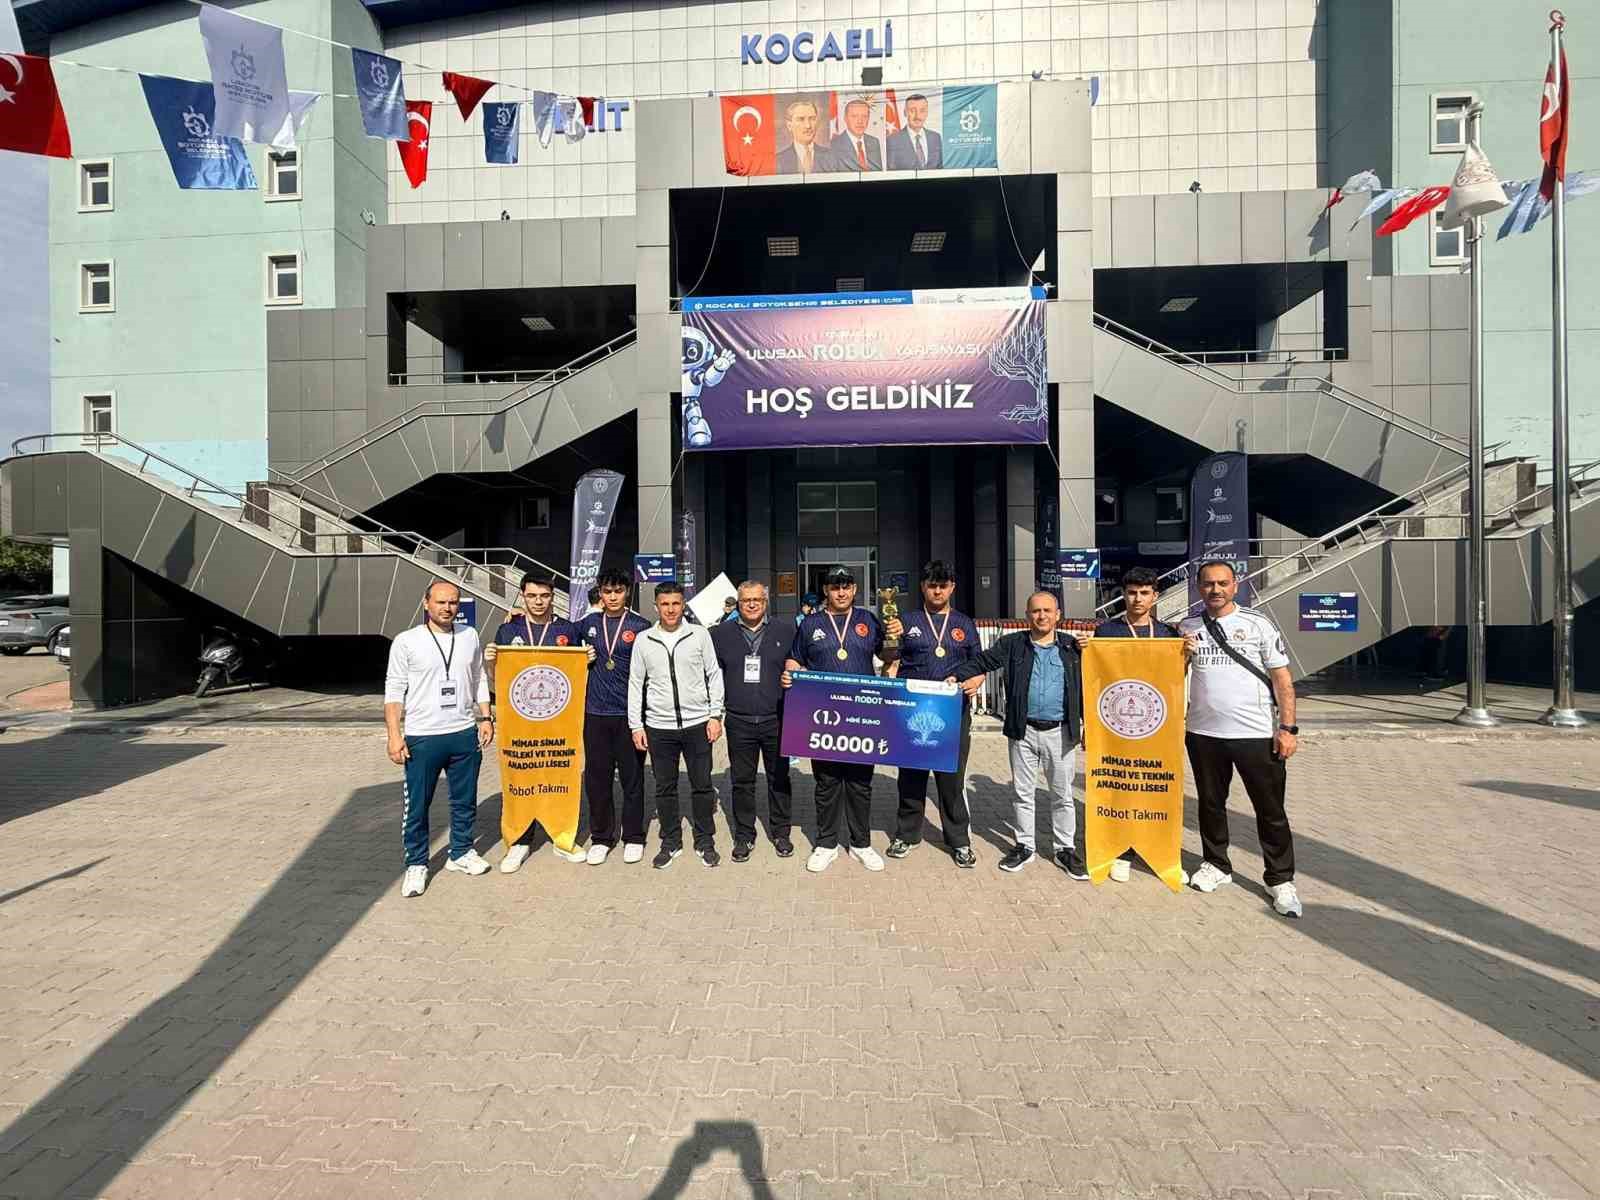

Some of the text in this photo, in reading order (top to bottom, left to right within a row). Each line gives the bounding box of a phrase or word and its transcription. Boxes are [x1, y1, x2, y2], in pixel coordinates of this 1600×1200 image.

[741, 19, 893, 65] KOCAELİ
[746, 378, 974, 418] HOŞ GELDİNİZ
[813, 709, 840, 726] (1.)
[512, 738, 565, 747] MİMAR SİNAN
[809, 732, 874, 754] 50.000
[508, 761, 544, 770] ANADOLU
[1101, 756, 1163, 768] MİMAR SİNAN
[1091, 768, 1175, 781] MESLEKİ VE TEKNİK
[509, 784, 569, 796] Robot Takımı
[1096, 781, 1168, 793] ANADOLU LİSESİ
[1097, 806, 1168, 821] Robot Takımı
